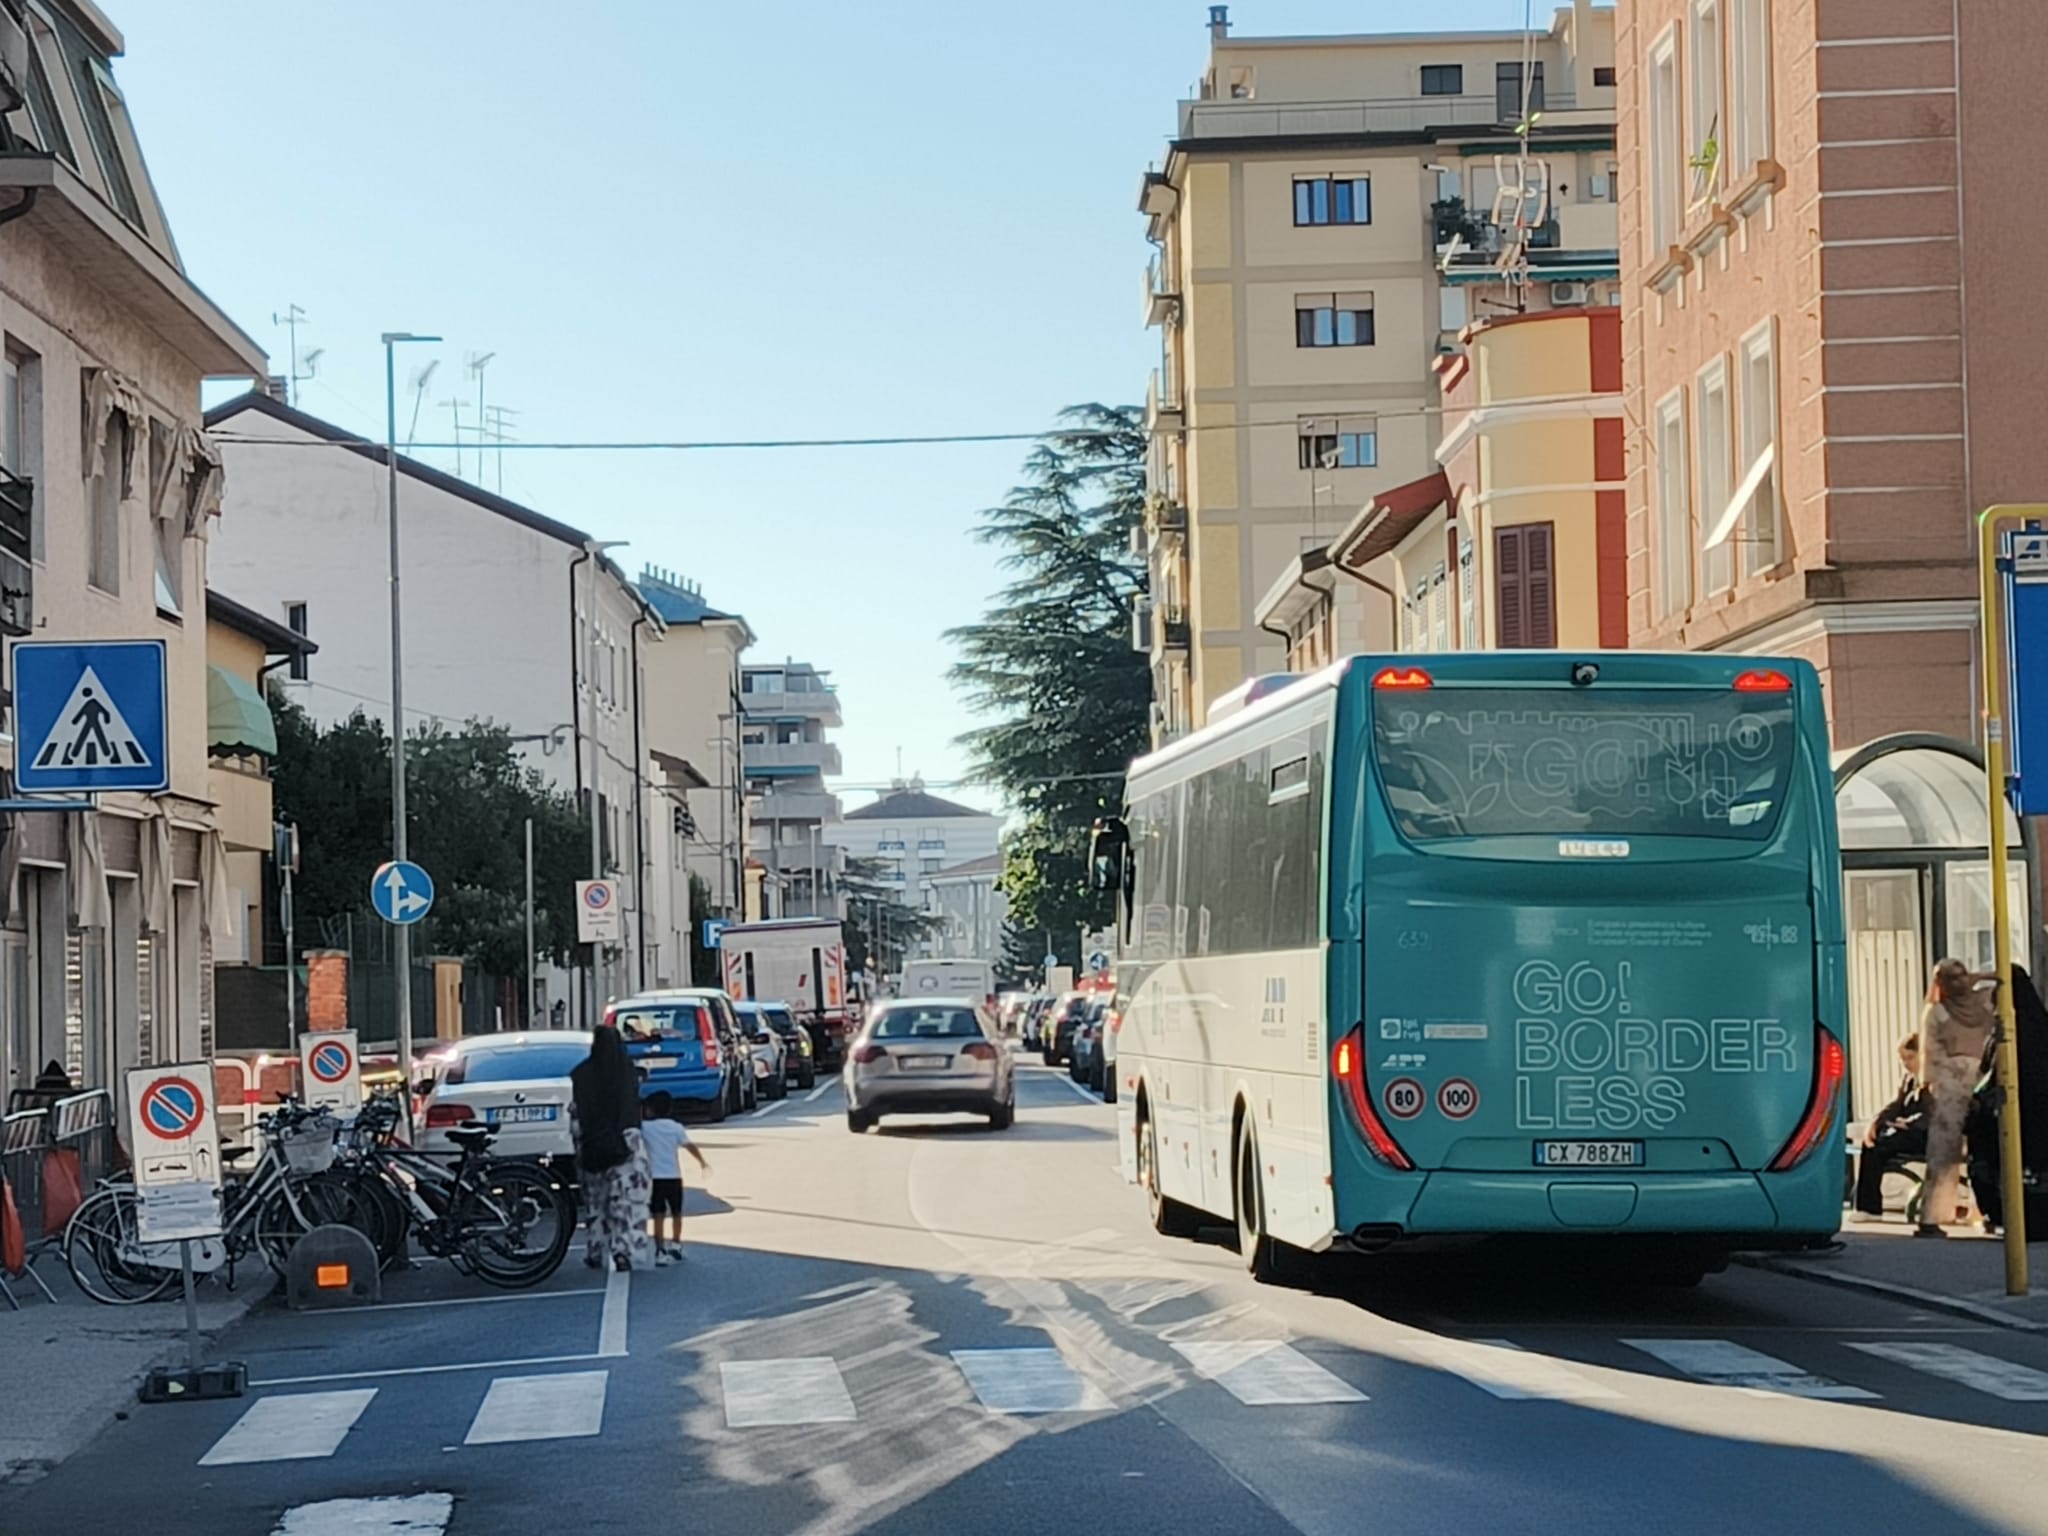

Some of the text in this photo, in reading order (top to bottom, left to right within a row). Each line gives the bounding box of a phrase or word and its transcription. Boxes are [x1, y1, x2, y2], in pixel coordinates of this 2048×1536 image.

[1513, 960, 1632, 1015] GO!
[1515, 1018, 1798, 1072] BORDER
[1394, 1089, 1415, 1107] 80
[1446, 1089, 1471, 1107] 100
[1515, 1075, 1687, 1130] LESS
[1547, 1143, 1633, 1163] CX 788ZH
